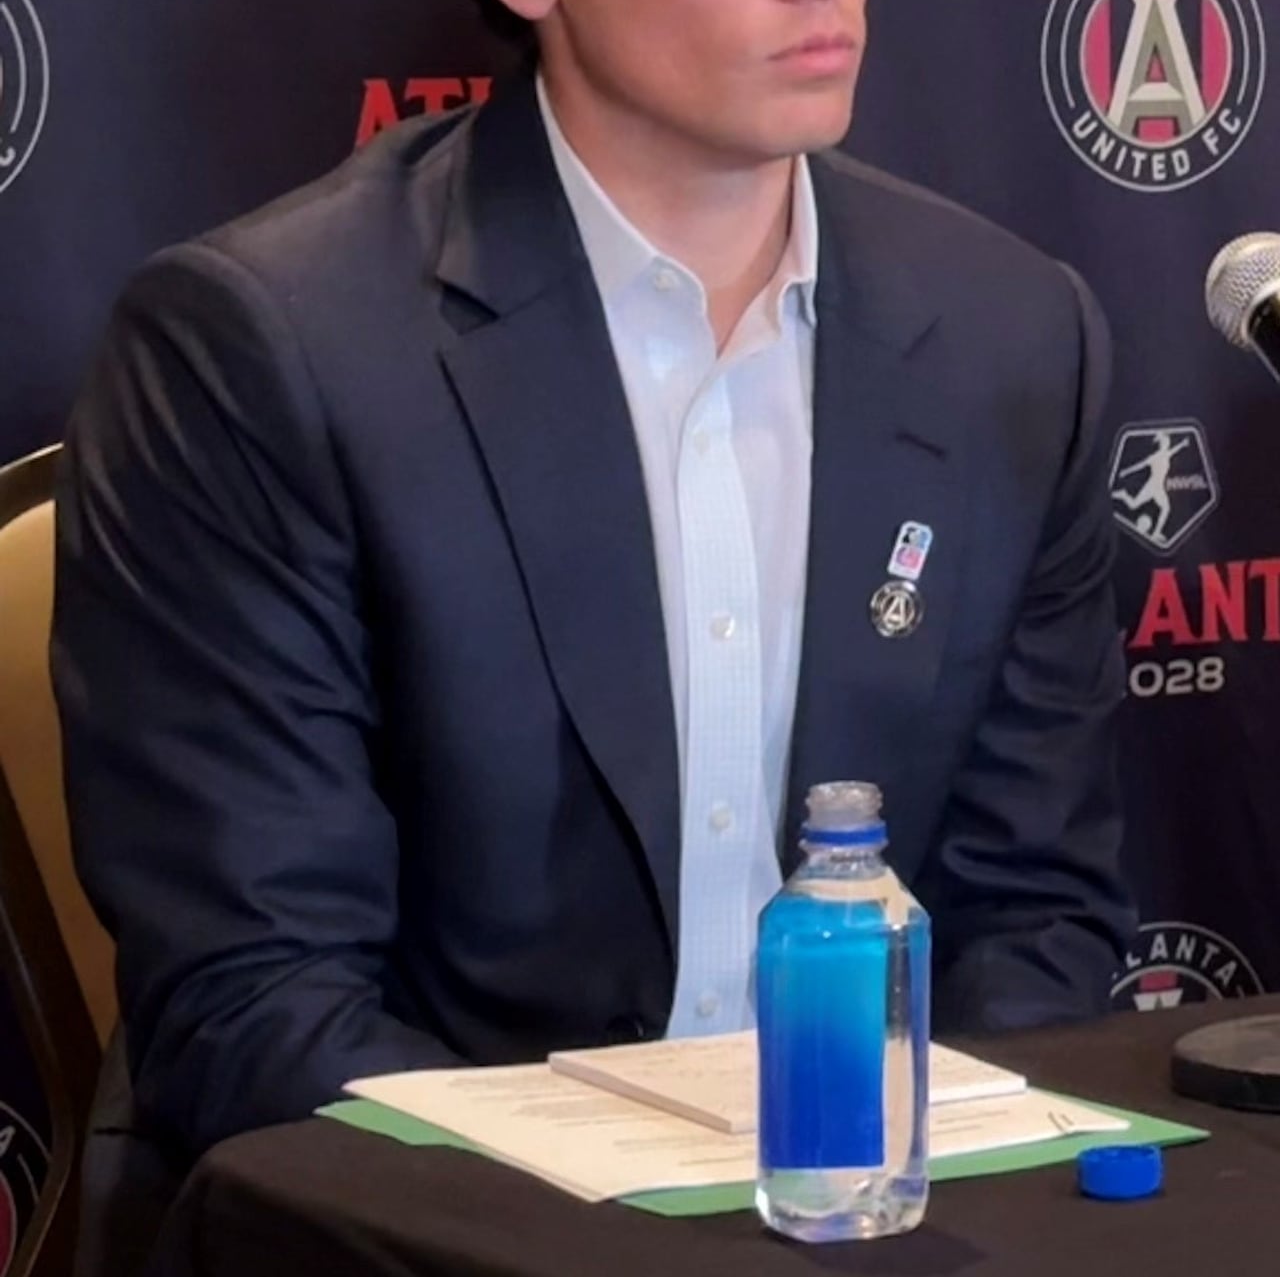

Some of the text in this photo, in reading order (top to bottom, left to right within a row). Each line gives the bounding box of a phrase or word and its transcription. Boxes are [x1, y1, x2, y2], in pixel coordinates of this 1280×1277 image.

[1072, 108, 1241, 181] UNITED FC
[1129, 656, 1225, 698] 028
